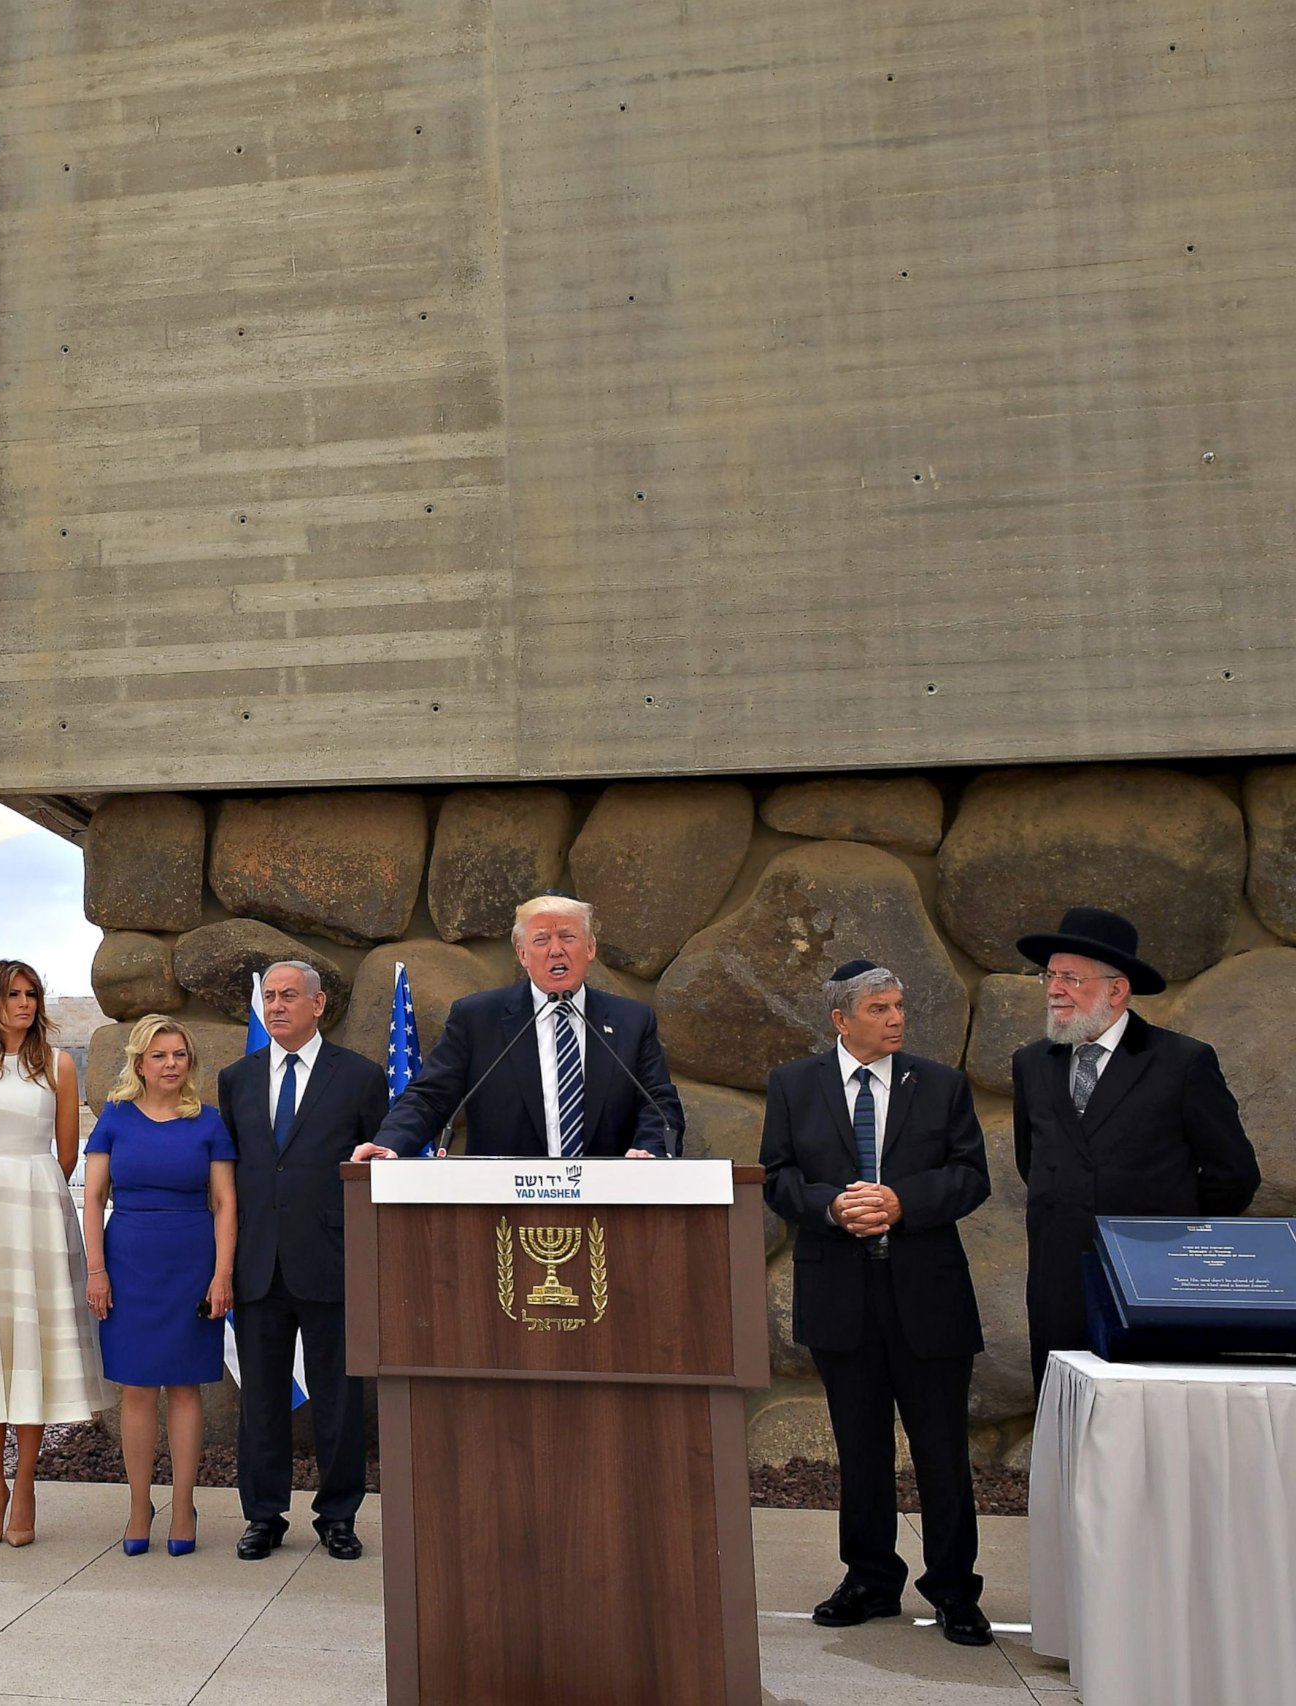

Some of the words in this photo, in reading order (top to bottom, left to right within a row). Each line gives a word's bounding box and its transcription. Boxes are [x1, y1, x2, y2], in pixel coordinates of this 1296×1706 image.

[514, 1175, 543, 1187] ושם
[546, 1175, 562, 1187] יד
[516, 1188, 535, 1199] YAD
[537, 1188, 581, 1199] VASHEM
[521, 1308, 586, 1331] ישראל
